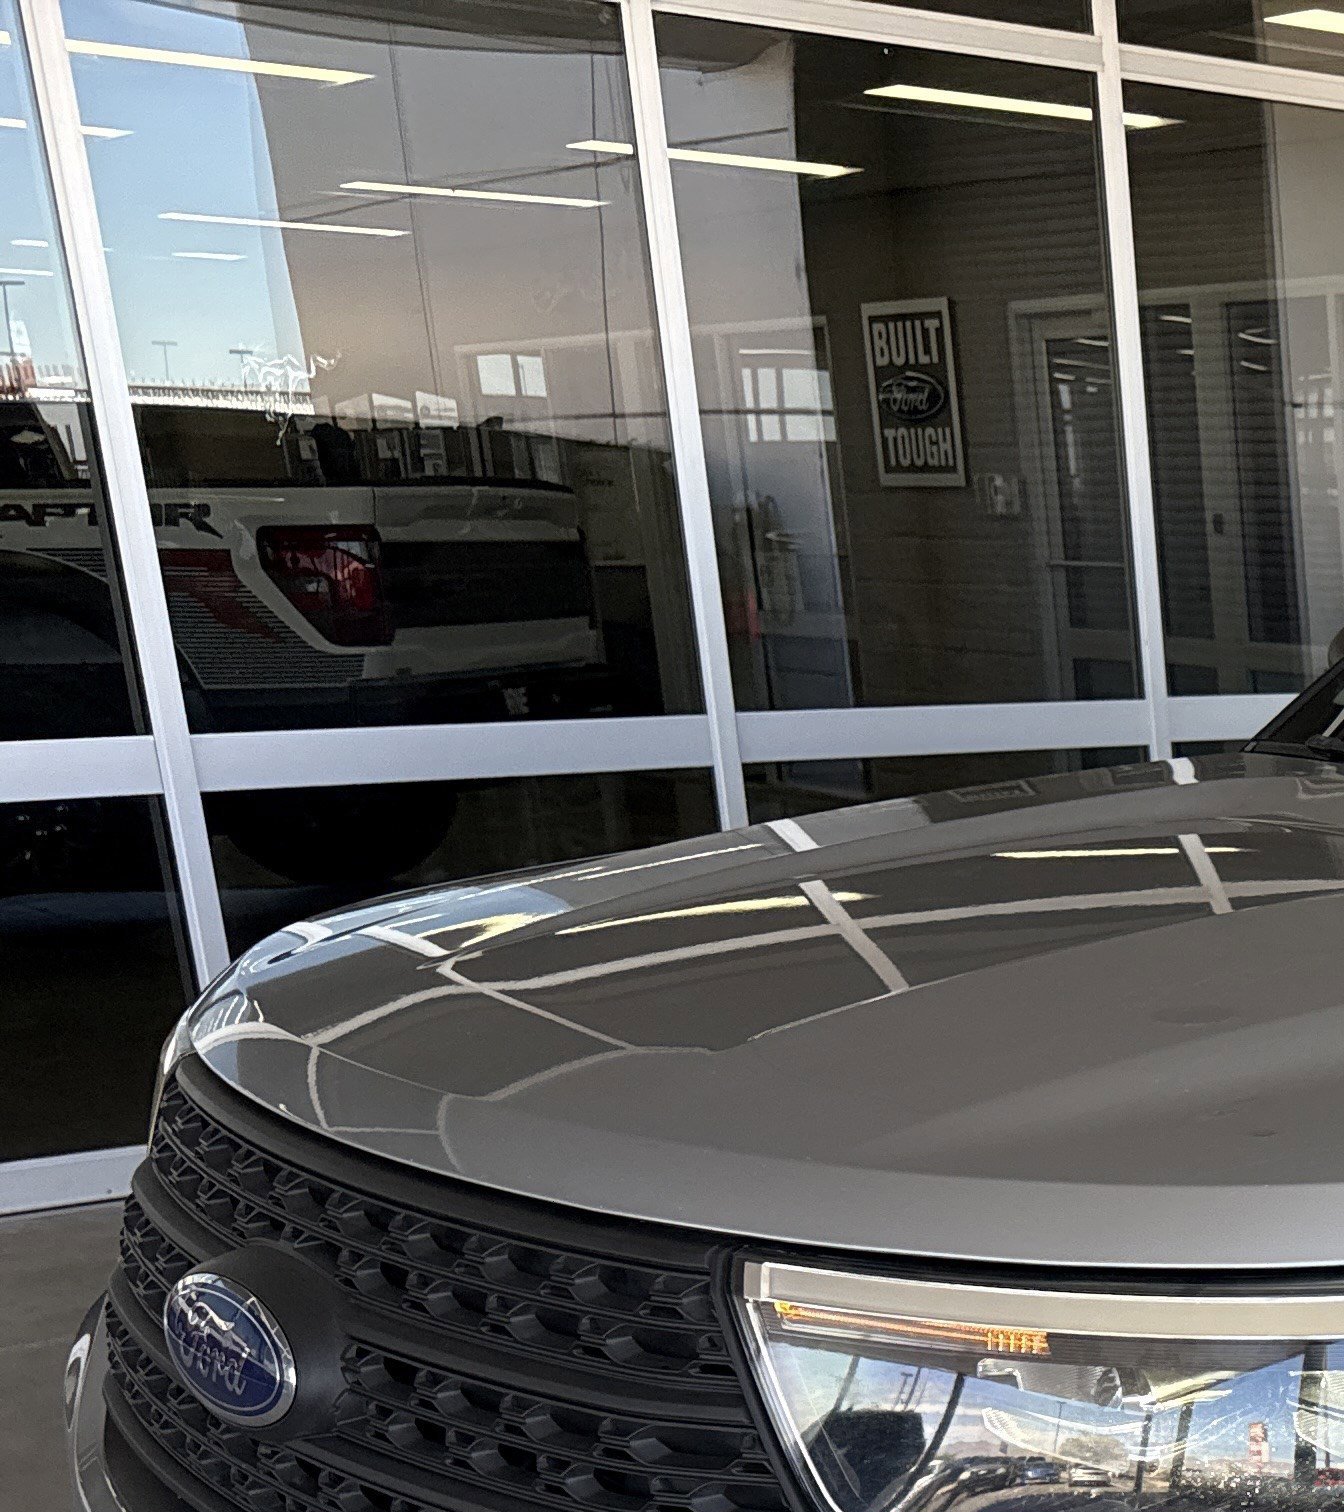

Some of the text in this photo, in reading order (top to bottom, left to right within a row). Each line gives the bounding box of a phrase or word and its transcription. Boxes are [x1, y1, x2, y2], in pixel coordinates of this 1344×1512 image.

[872, 318, 941, 367] BUILT
[879, 377, 933, 412] Ford
[884, 426, 954, 467] TOUGH
